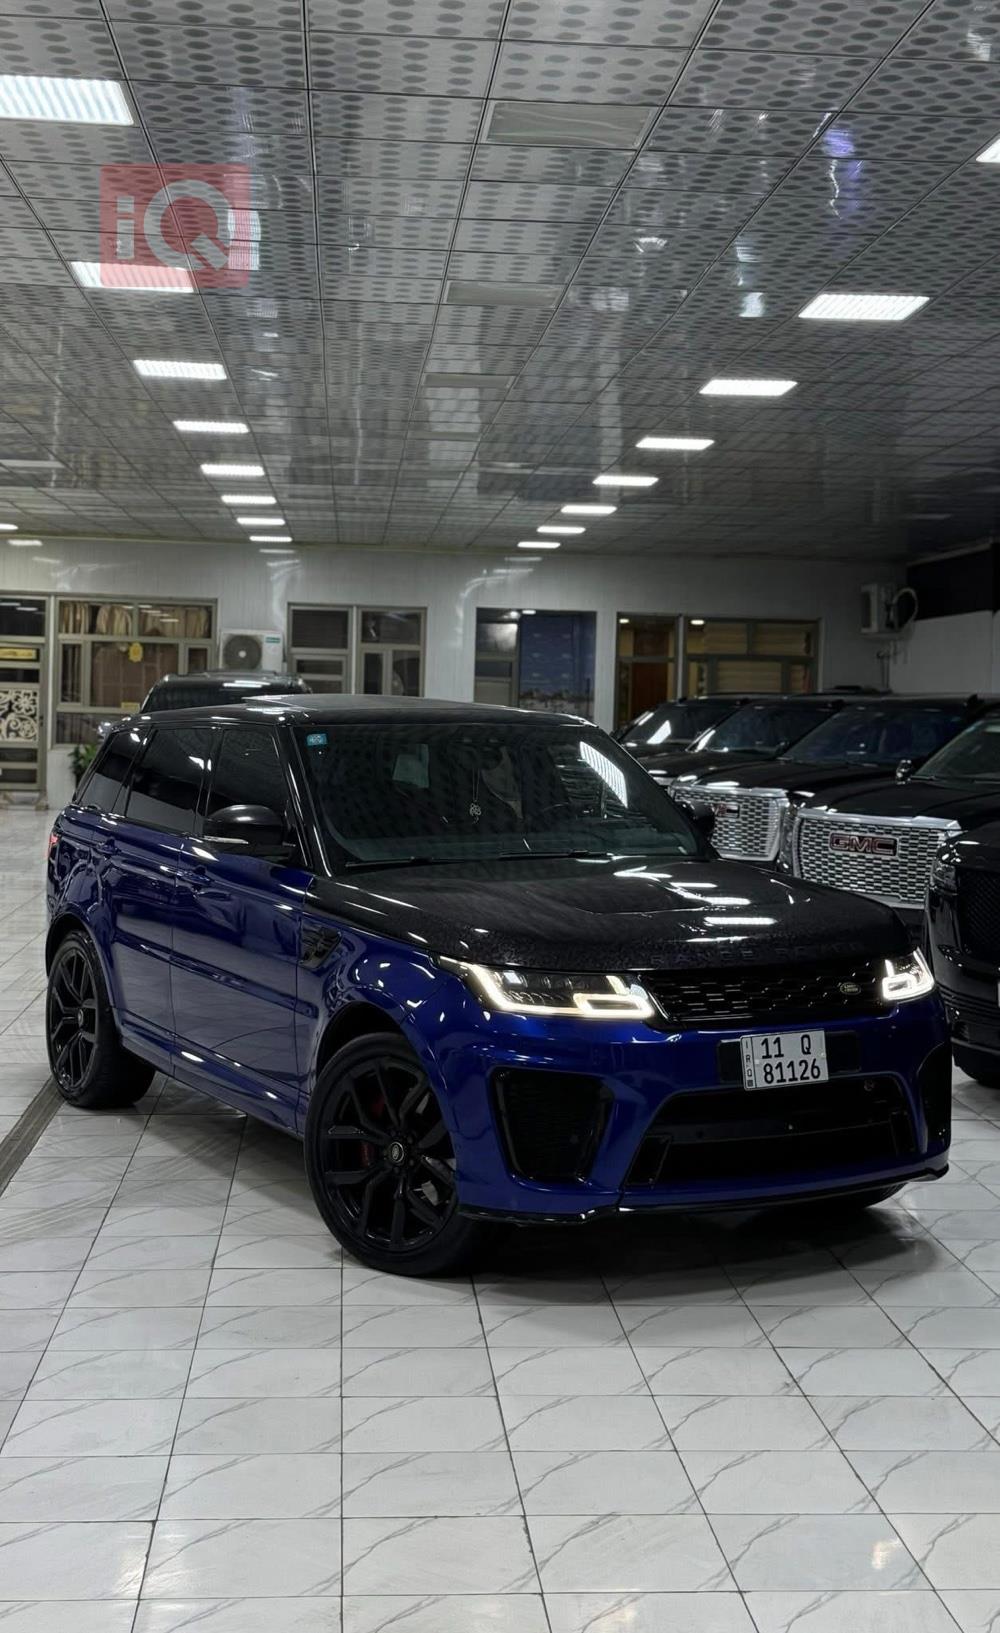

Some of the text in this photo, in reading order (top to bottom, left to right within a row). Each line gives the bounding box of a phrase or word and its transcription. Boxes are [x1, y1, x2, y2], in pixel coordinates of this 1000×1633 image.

[832, 834, 894, 856] GMC
[761, 1034, 811, 1059] 11 Q
[763, 1058, 821, 1084] 81126
